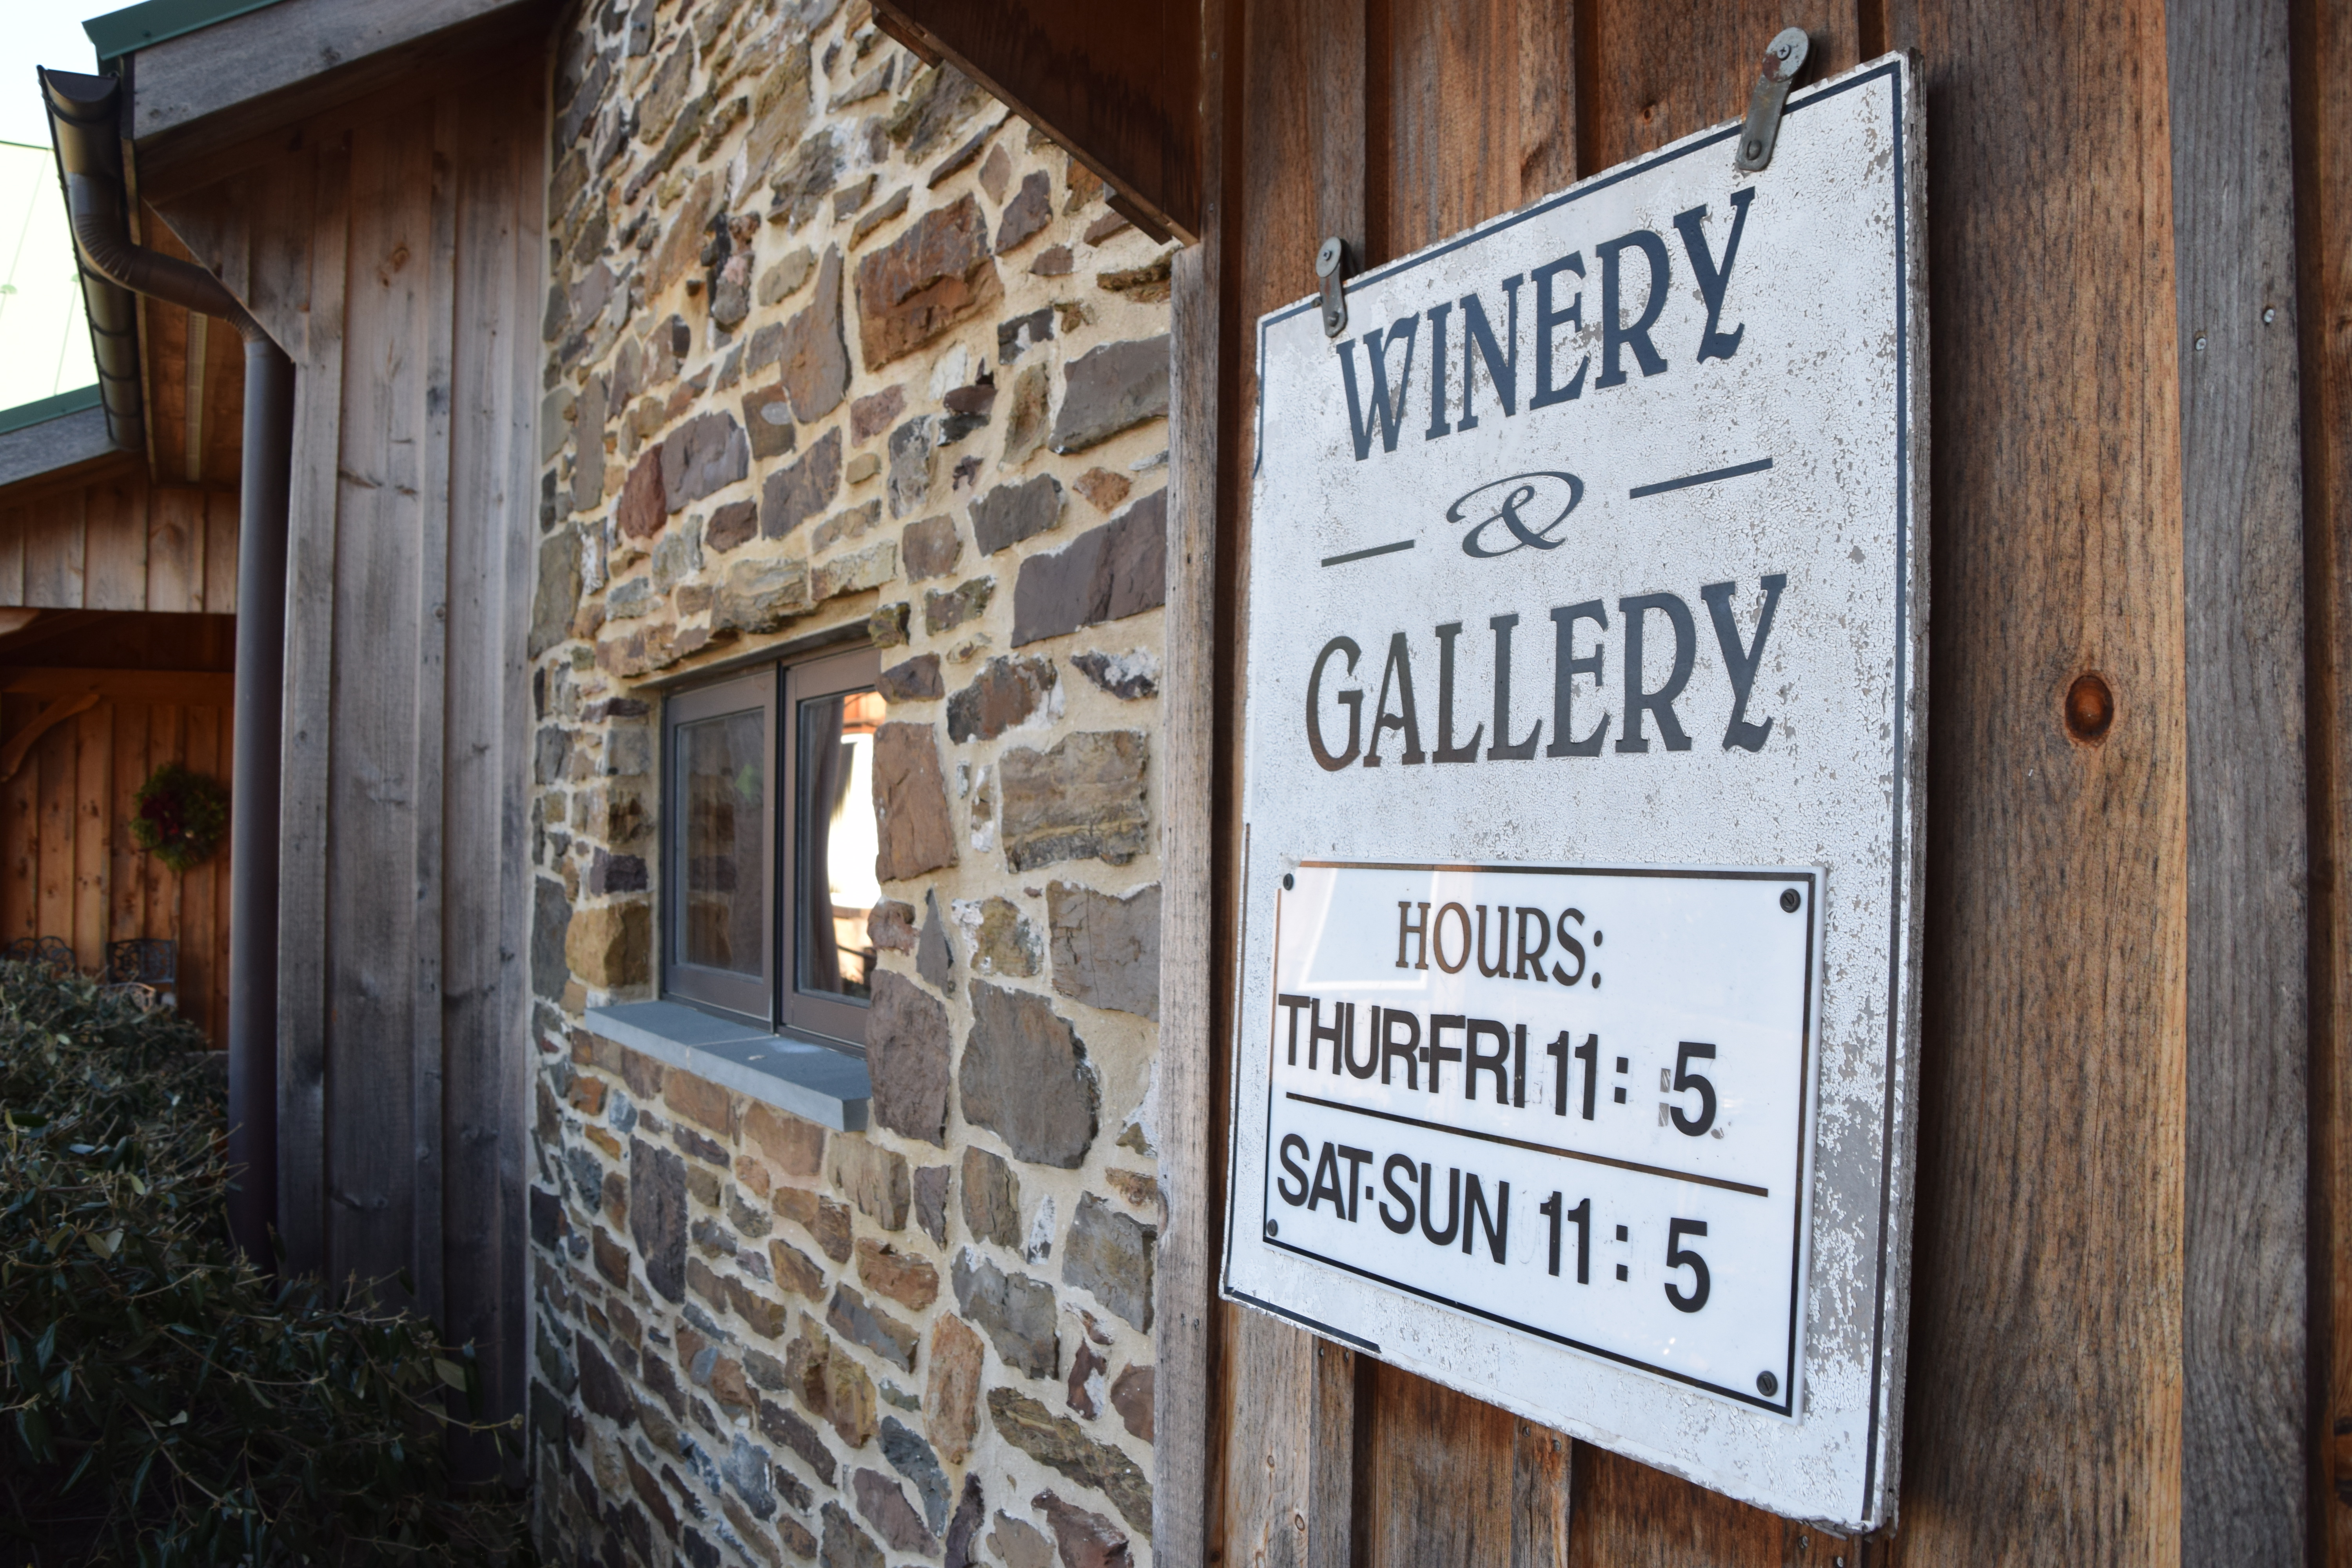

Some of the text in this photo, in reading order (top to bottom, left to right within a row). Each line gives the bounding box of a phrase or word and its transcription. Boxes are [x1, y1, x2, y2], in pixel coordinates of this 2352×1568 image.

[1336, 185, 1755, 462] WINERY
[1446, 471, 1584, 559] &
[1306, 573, 1788, 772] GALLERY
[1396, 901, 1603, 989] HOURS:
